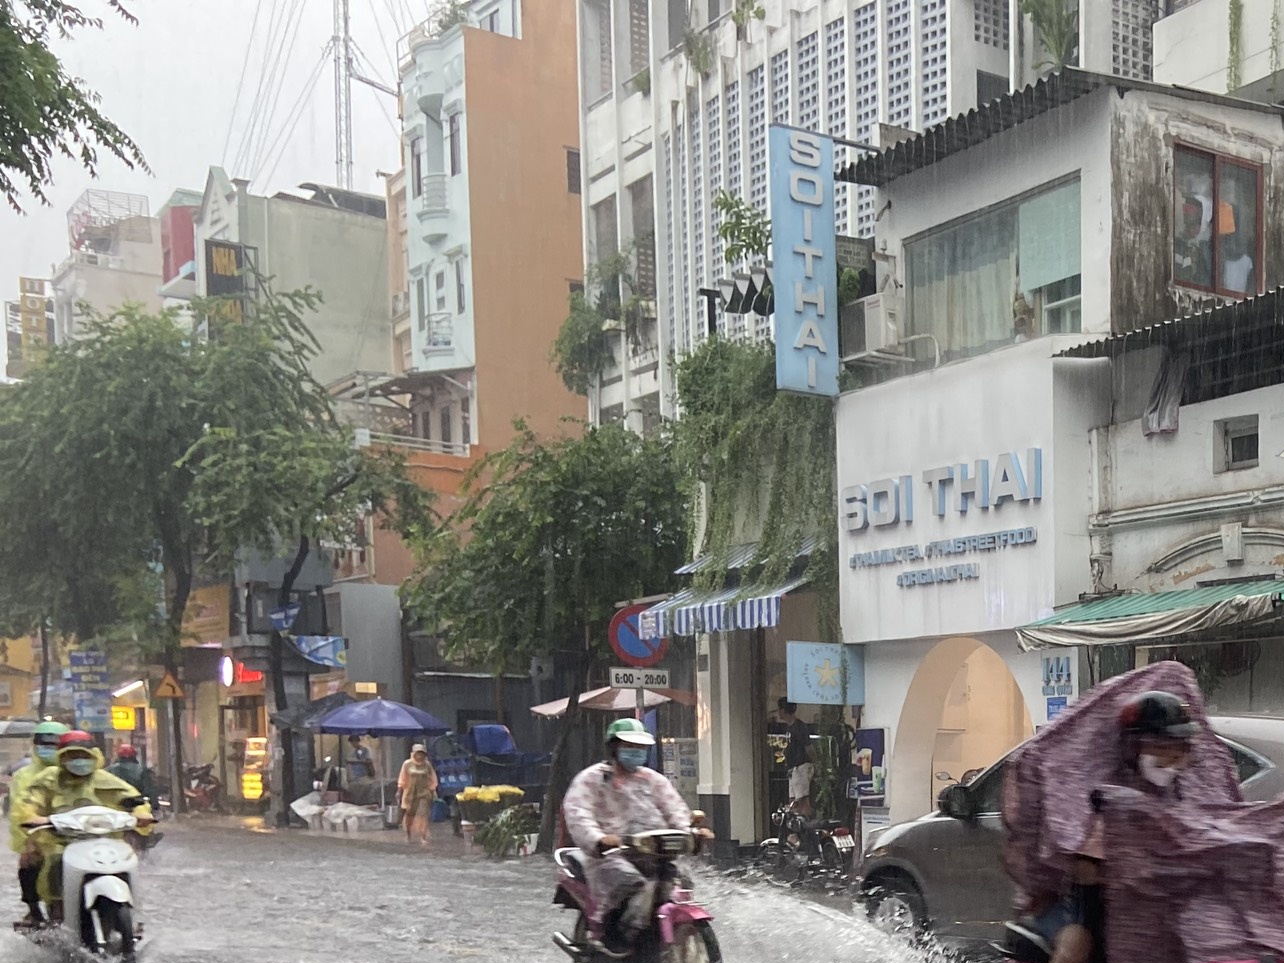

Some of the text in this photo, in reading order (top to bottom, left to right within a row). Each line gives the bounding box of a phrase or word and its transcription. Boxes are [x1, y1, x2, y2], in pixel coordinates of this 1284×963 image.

[840, 447, 1042, 531] SOI THAI
[614, 673, 634, 685] 6:00
[644, 674, 667, 686] 20:00
[1042, 656, 1071, 682] 144
